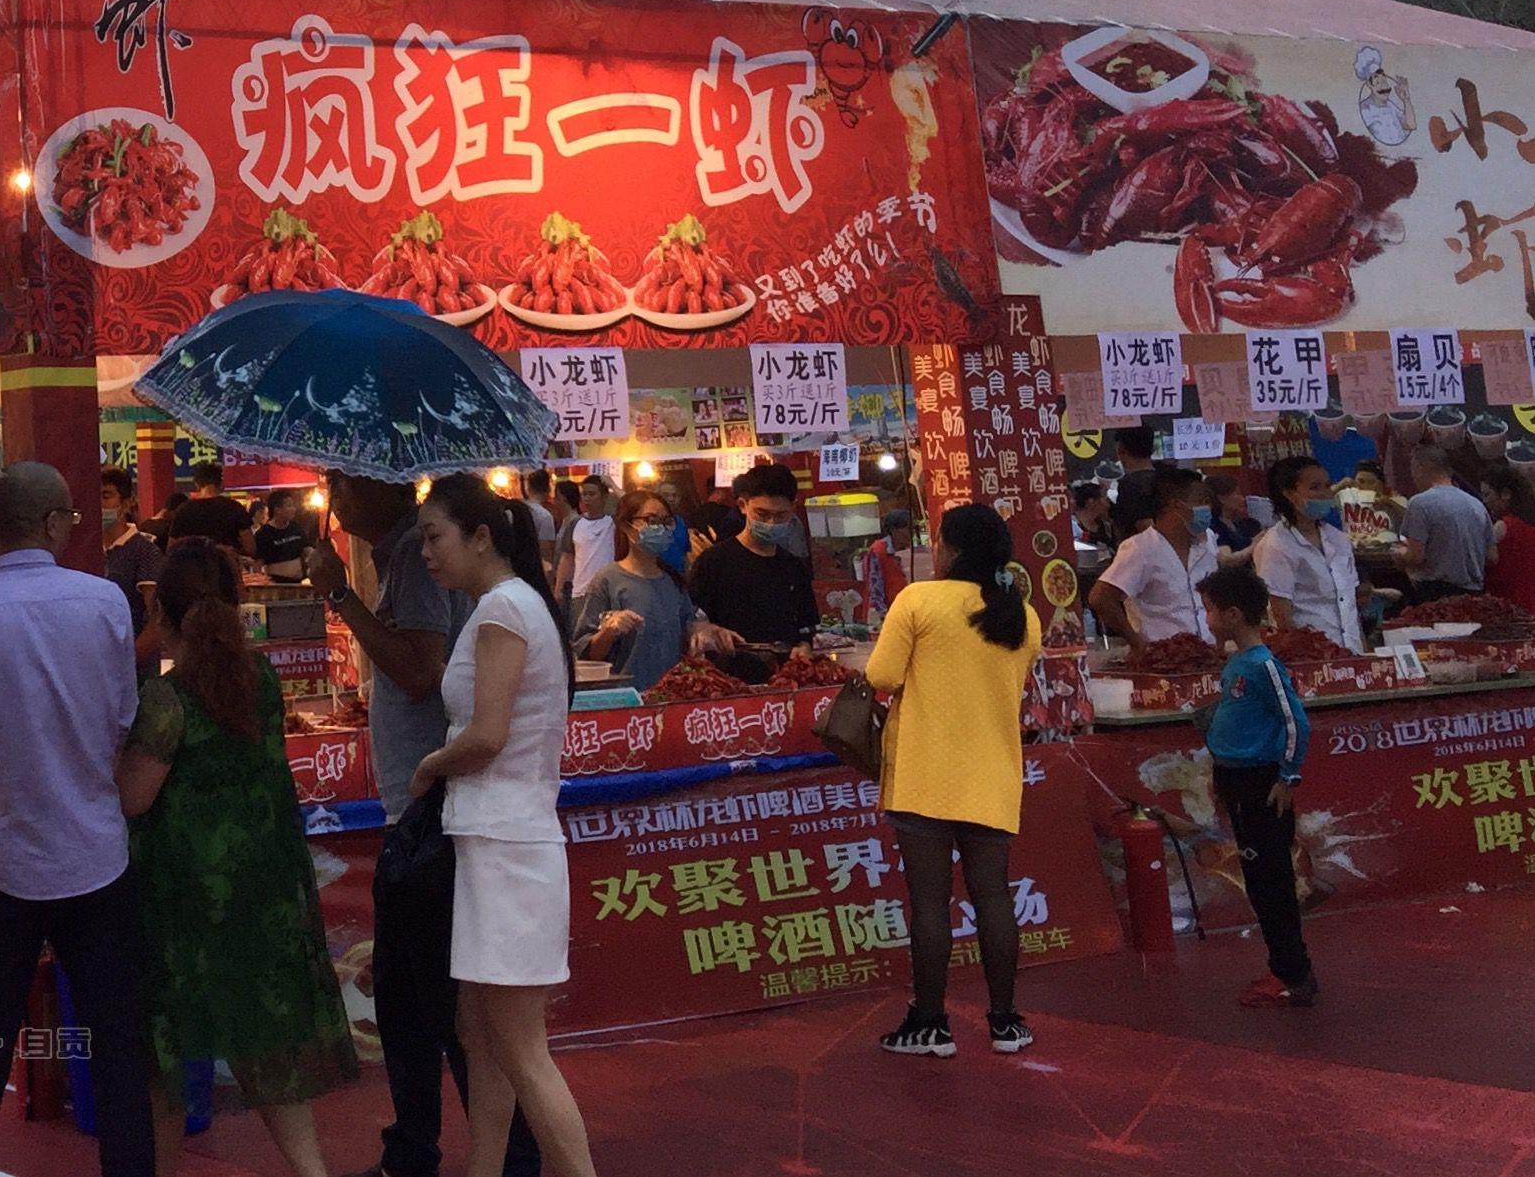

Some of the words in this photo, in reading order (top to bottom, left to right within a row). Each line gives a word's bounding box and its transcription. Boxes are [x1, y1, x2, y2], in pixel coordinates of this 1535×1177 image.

[232, 14, 826, 214] 疯狂一虾
[1429, 78, 1535, 165] 小
[755, 190, 937, 300] 又到了吃虾的季节
[757, 350, 839, 381] 小龙虾
[1106, 338, 1175, 367] 小龙虾
[1252, 336, 1322, 376] 花甲
[1396, 334, 1460, 372] 扇贝
[529, 354, 617, 386] 小龙虾
[1109, 367, 1174, 386] 买3斤送1斤
[761, 382, 839, 402] 买3斤送1斤
[1110, 386, 1178, 409] 78元/斤
[1255, 378, 1323, 405] 35元/斤
[1398, 374, 1460, 400] 15元/4个
[762, 401, 841, 425] 78元/斤
[684, 701, 787, 744] 疯狂一虾
[1434, 736, 1526, 757] 2018年6月14日
[626, 827, 759, 856] 2018年6月14日
[790, 812, 884, 835] 2018年7月
[591, 837, 906, 922] 欢聚世界
